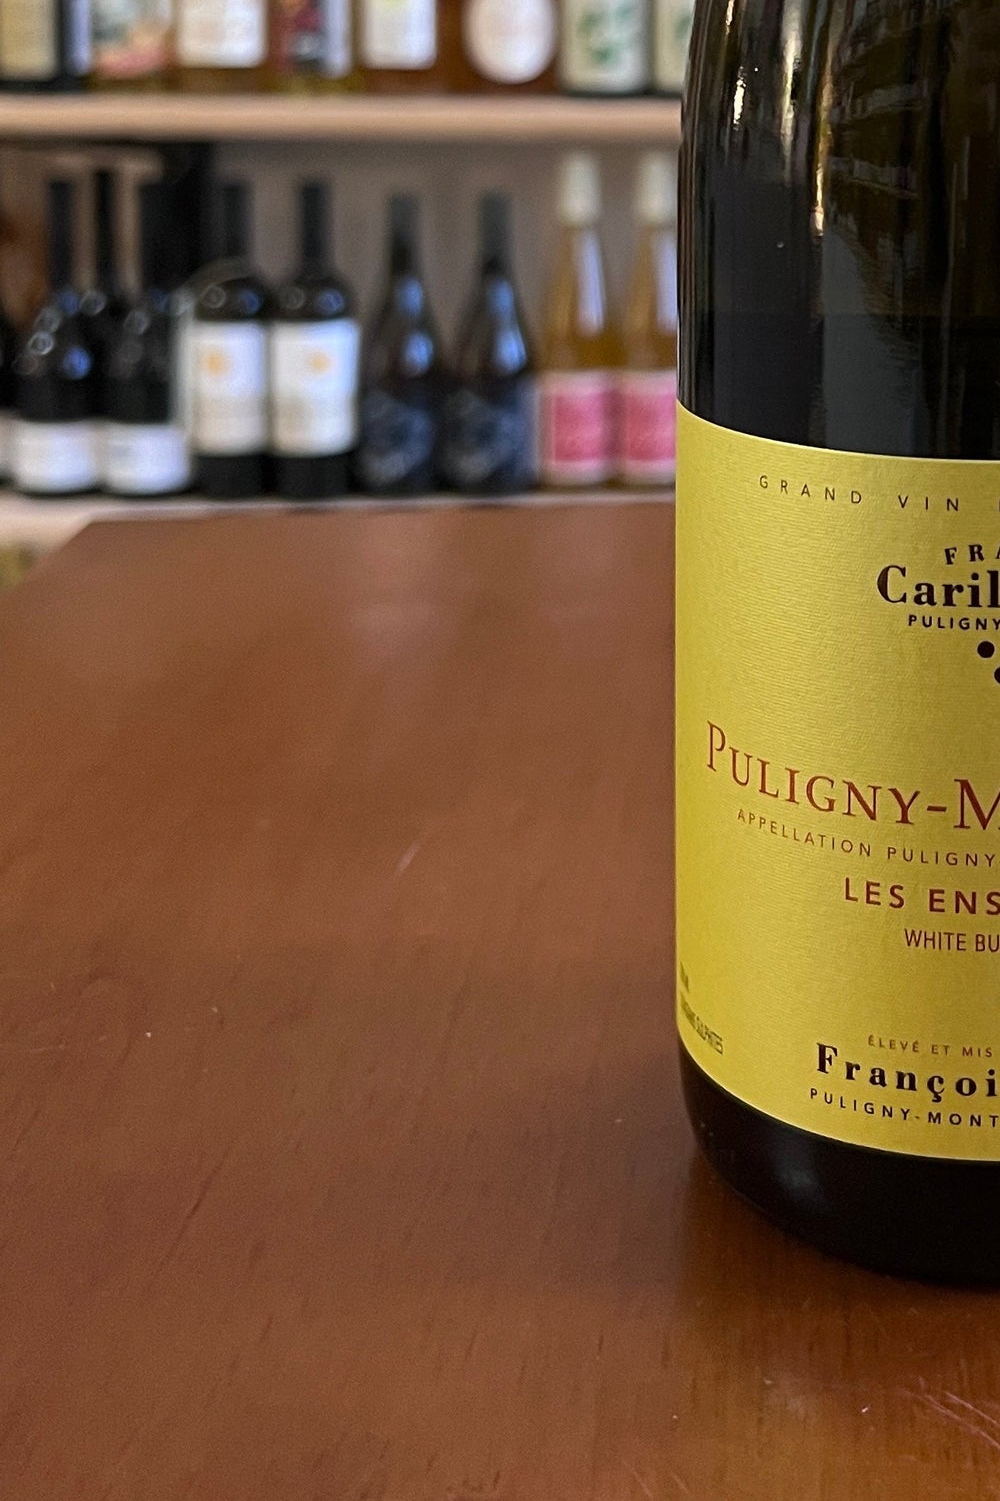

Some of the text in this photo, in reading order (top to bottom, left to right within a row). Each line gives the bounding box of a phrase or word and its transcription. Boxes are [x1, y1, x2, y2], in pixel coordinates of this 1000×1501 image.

[759, 475, 863, 504] GRAND
[898, 495, 959, 512] VIN
[737, 808, 871, 857] APPELLATION
[845, 876, 905, 909] LES
[904, 928, 967, 952] WHITE
[867, 1034, 920, 1054] ÉLEVÉ
[931, 1043, 949, 1056] ET
[962, 1045, 993, 1058] MIS
